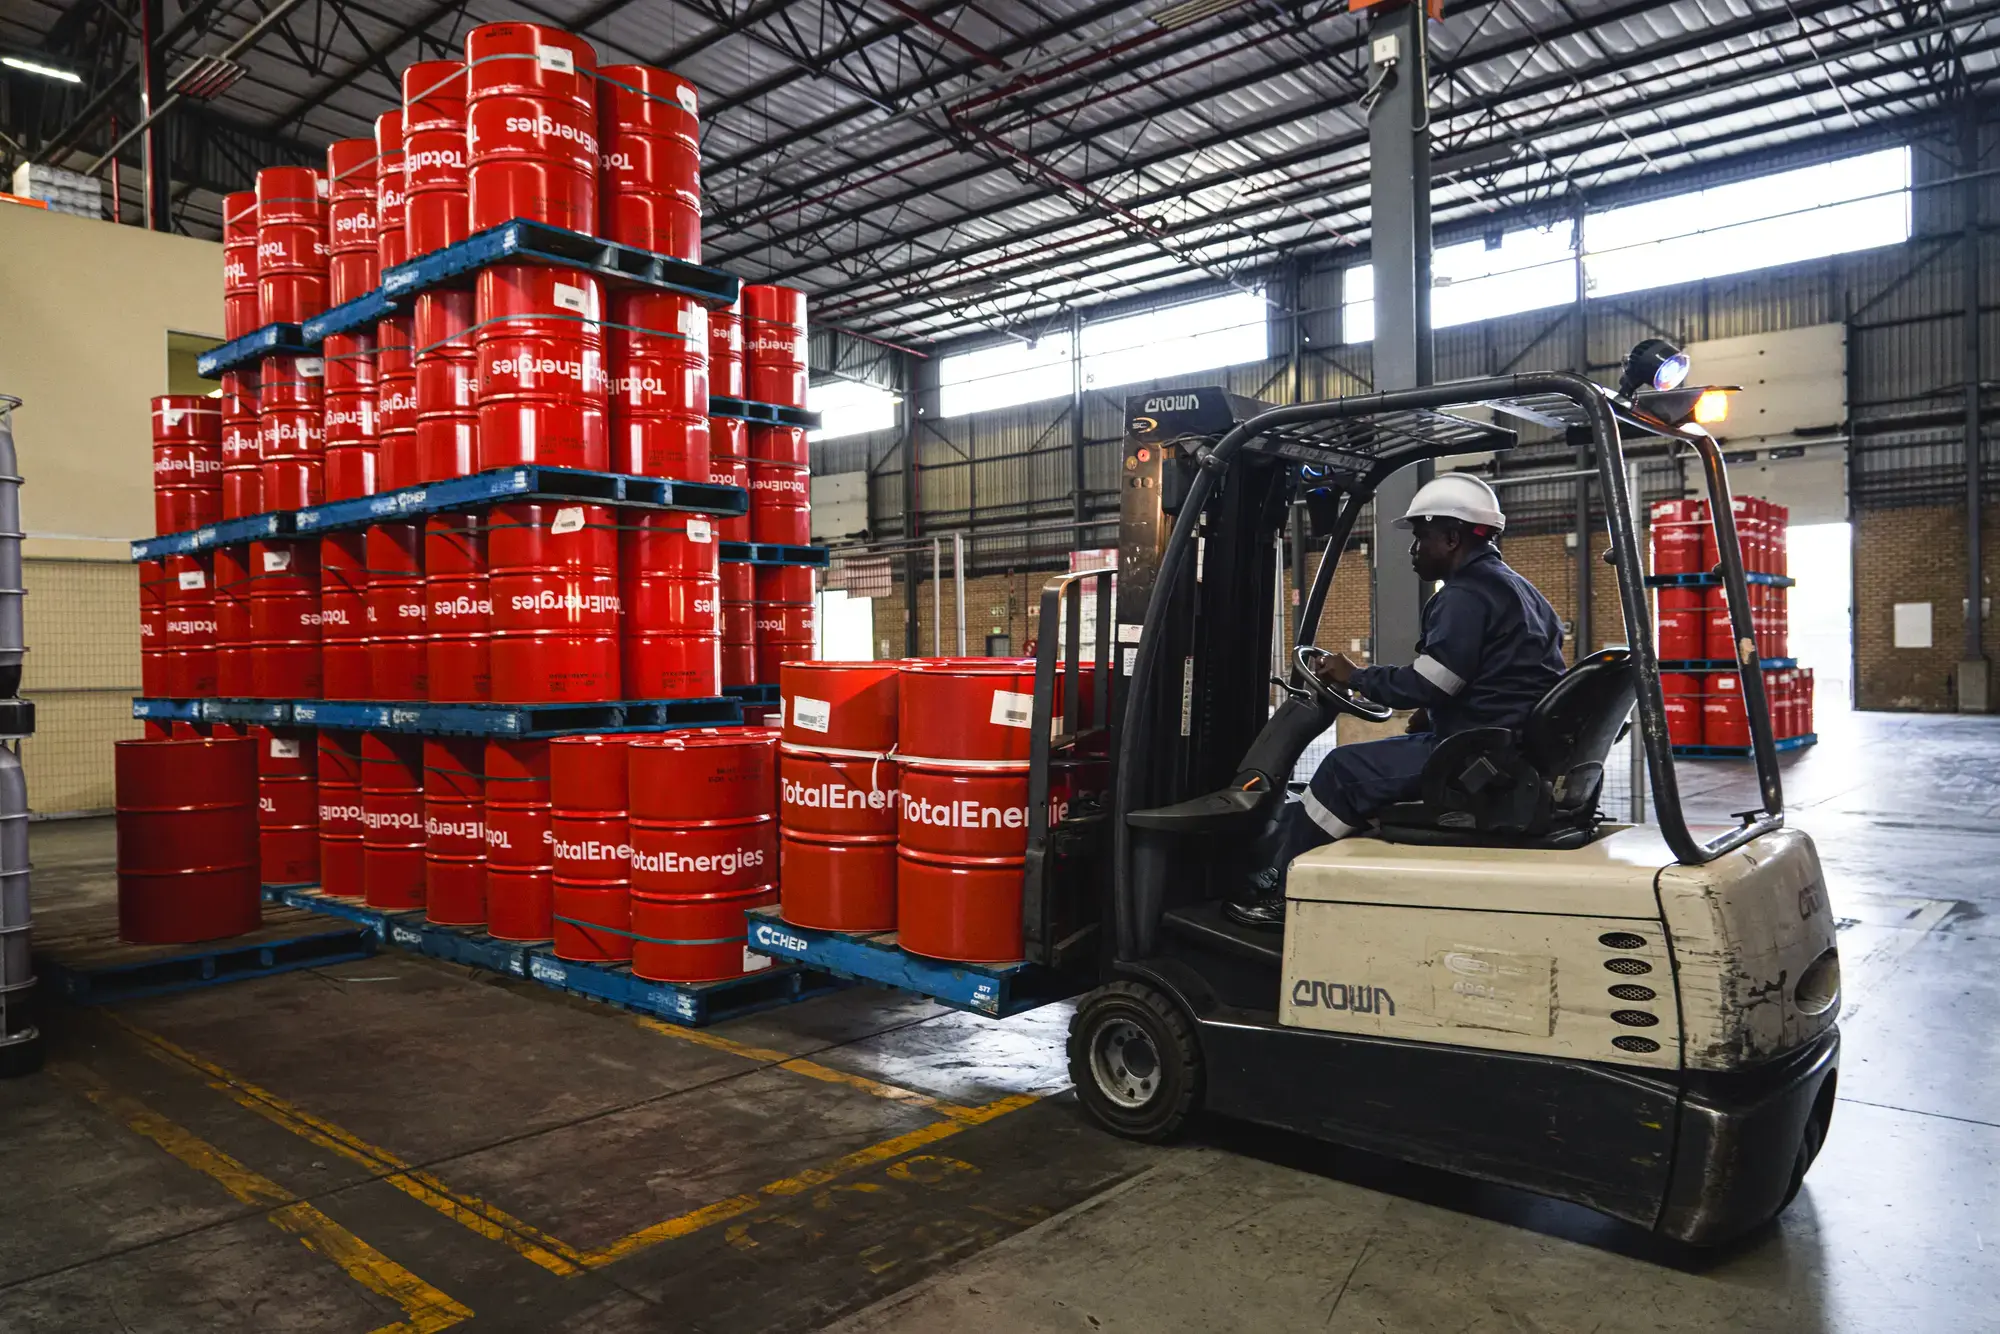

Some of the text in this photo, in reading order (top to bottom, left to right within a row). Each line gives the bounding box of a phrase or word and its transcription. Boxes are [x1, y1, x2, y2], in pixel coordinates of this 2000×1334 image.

[1145, 394, 1200, 413] CROWN
[631, 846, 764, 876] TotalEnergies
[771, 932, 808, 951] CHEP
[1292, 979, 1396, 1016] CROWN
